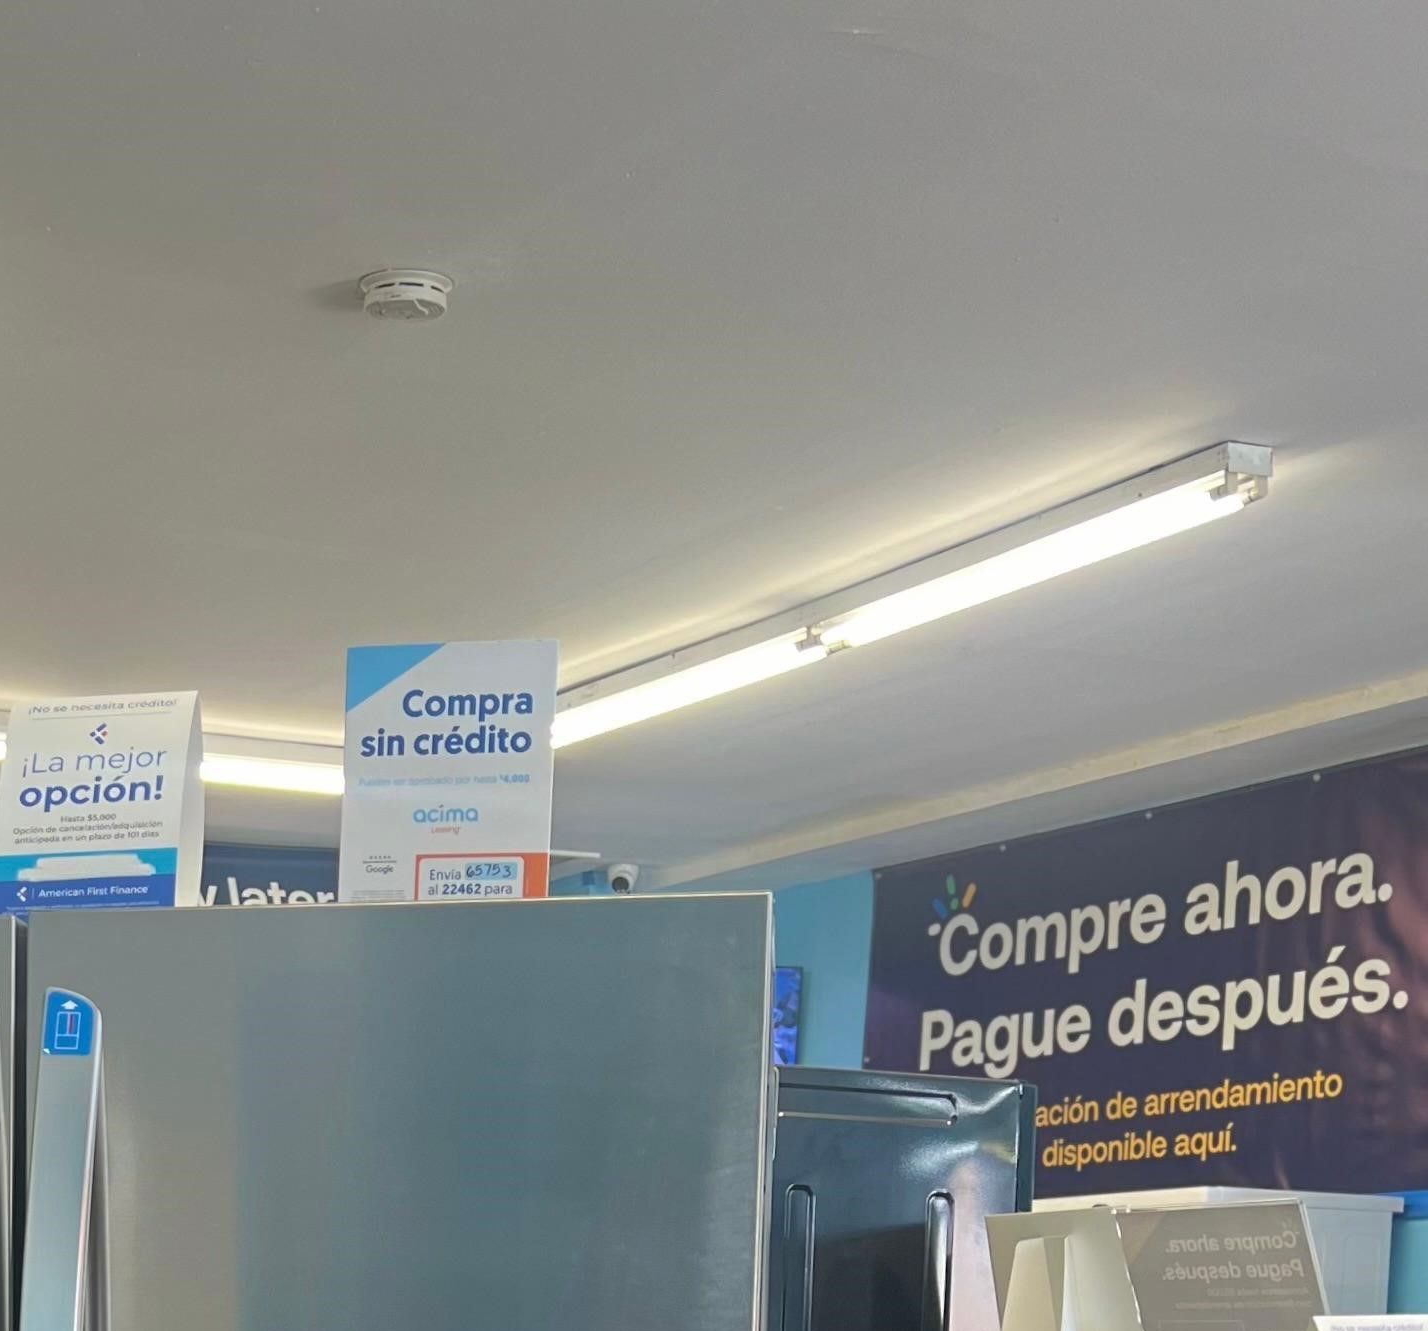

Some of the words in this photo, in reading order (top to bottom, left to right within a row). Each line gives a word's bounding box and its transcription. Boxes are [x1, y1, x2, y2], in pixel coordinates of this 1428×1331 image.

[403, 689, 533, 722] Compra
[360, 728, 405, 757] sin
[414, 725, 532, 755] crédito
[22, 753, 64, 778] ¡La
[76, 747, 167, 773] mejor
[20, 775, 164, 812] opción!
[13, 826, 44, 836] Opción
[61, 815, 85, 823] Hasta
[365, 864, 394, 875] Google
[429, 869, 462, 881] Envía
[38, 888, 85, 898] American
[87, 887, 108, 896] First
[110, 886, 148, 895] Finance
[428, 884, 438, 896] al
[442, 883, 482, 895] 22462
[484, 884, 513, 897] para
[939, 893, 1167, 976] Compre
[1184, 852, 1393, 936] ahora.
[919, 1004, 1091, 1079] Pague
[1108, 945, 1409, 1051] después.
[1035, 1095, 1099, 1128] ación
[1106, 1091, 1137, 1121] de
[1144, 1070, 1343, 1117] arrendamiento
[1042, 1131, 1168, 1172] disponible
[1174, 1122, 1237, 1162] aquí.
